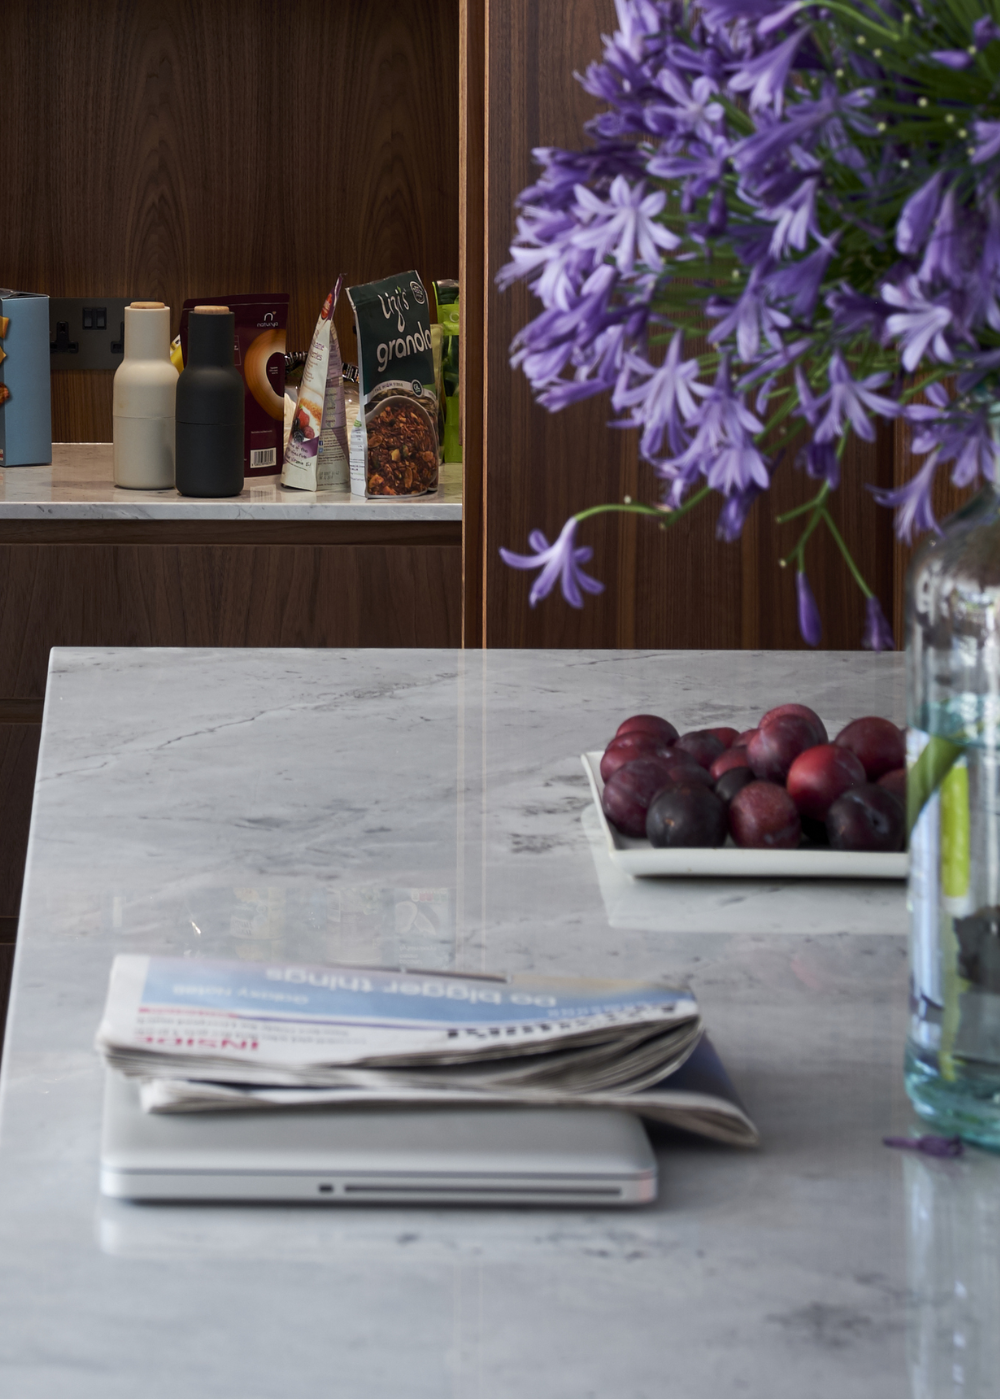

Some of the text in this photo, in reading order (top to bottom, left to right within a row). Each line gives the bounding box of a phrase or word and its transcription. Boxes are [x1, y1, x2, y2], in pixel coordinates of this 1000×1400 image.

[263, 965, 373, 993] things
[380, 977, 502, 1007] bigger
[131, 1034, 260, 1053] INSIDE
